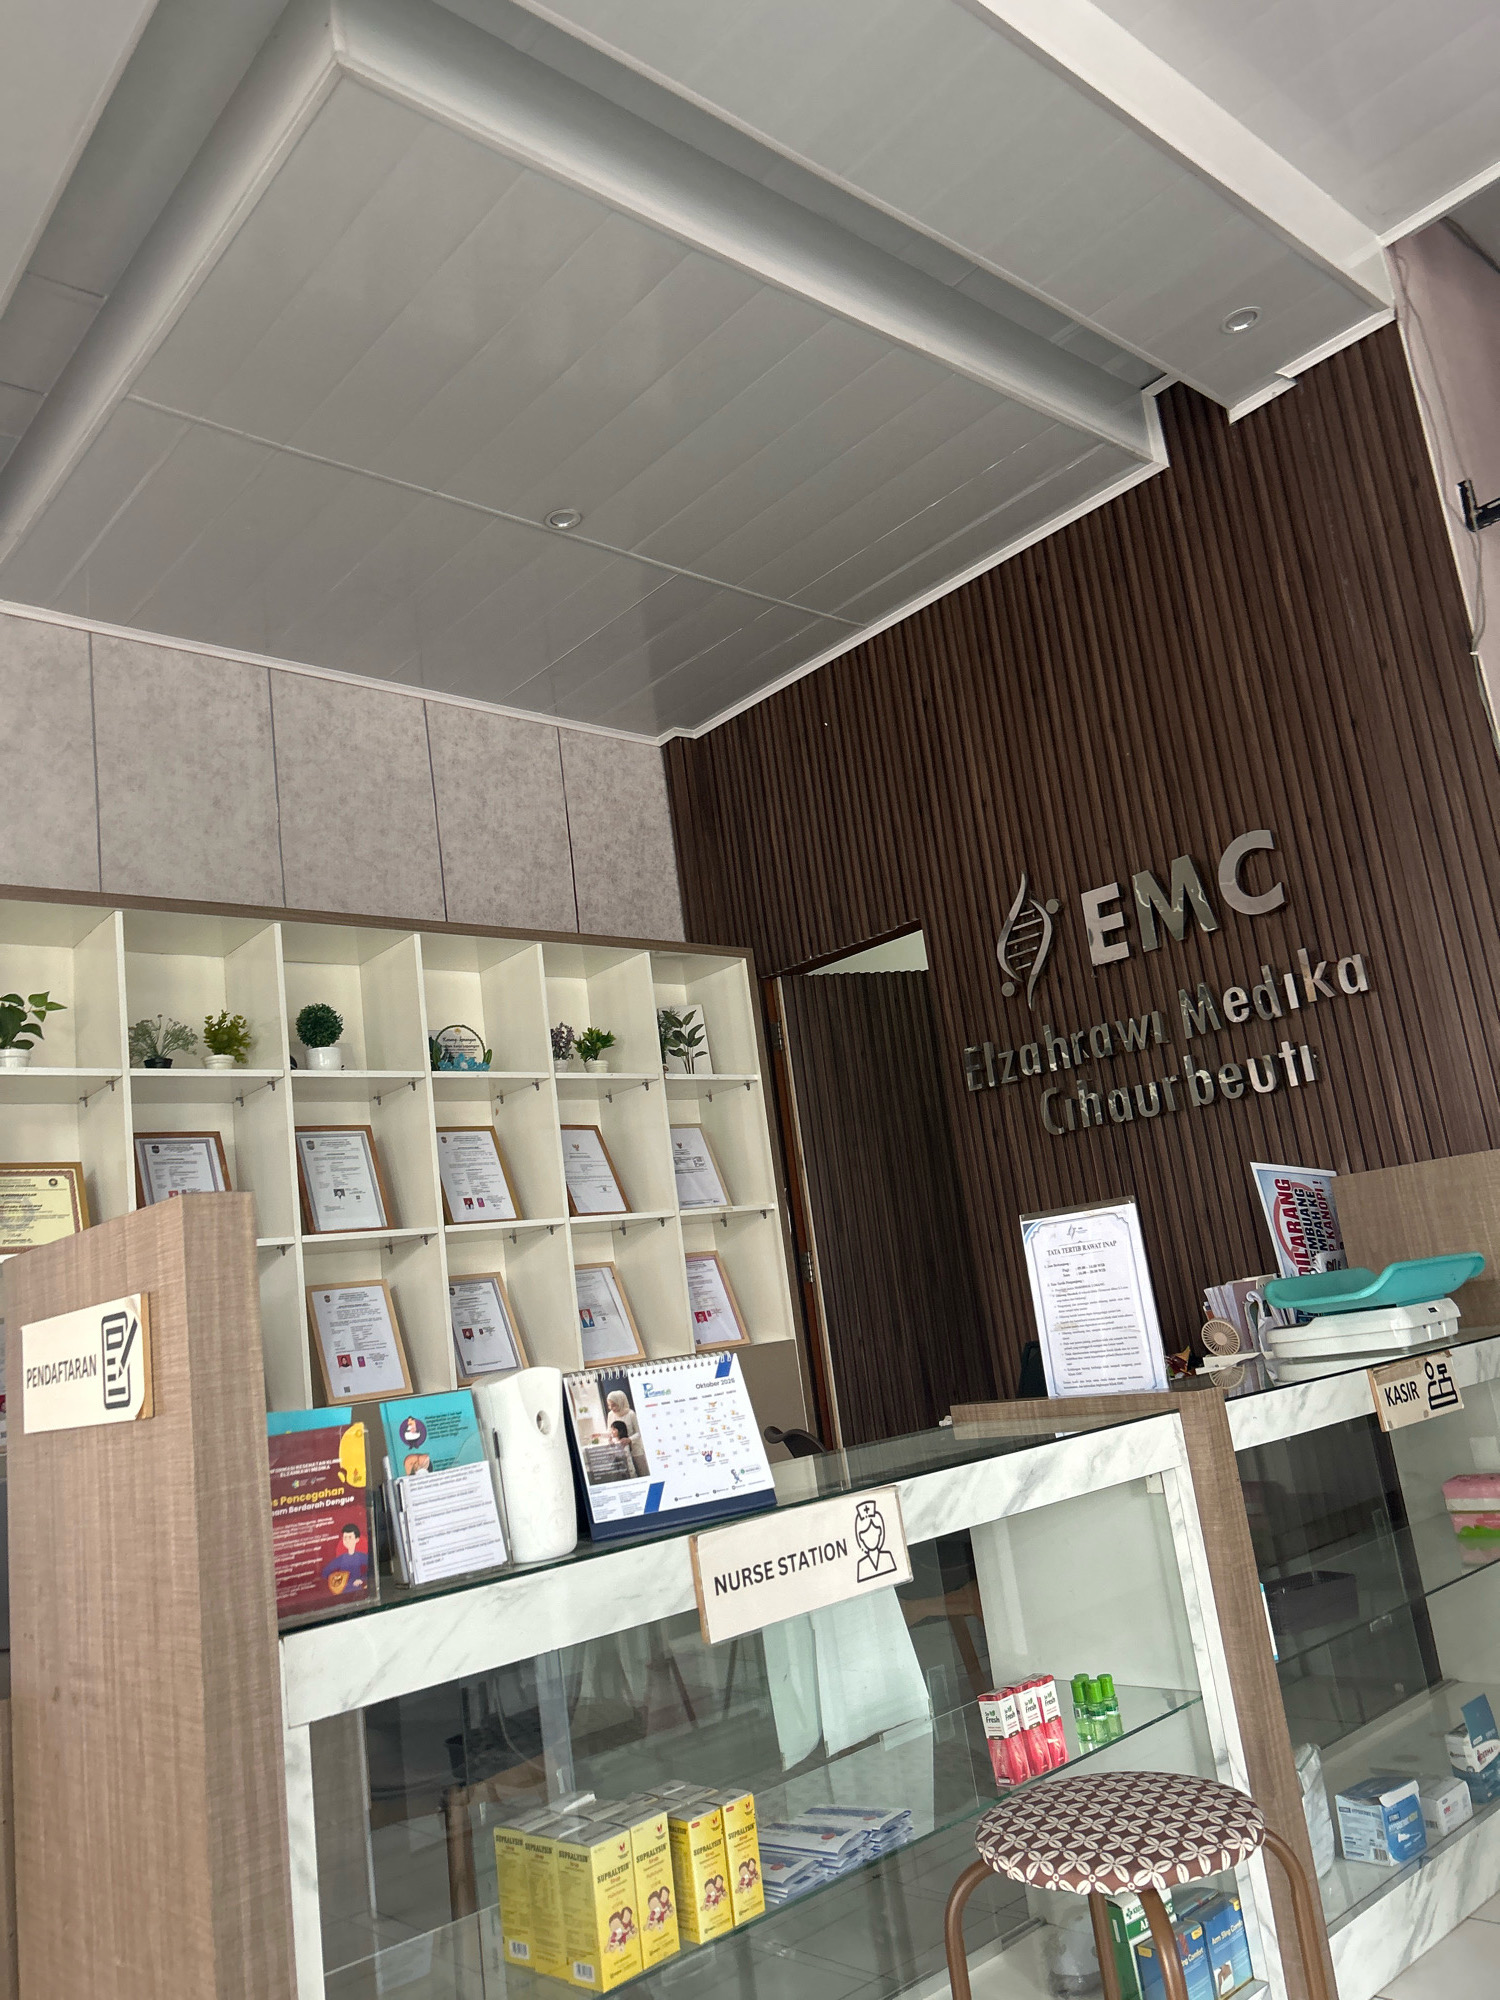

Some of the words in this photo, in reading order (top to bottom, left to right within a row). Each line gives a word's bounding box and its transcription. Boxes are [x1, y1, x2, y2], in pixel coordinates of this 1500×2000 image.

[1081, 829, 1286, 966] EMC
[964, 1010, 1170, 1092] Elzahrawi
[1178, 947, 1370, 1039] Medika
[1305, 1190, 1318, 1208] KE
[1314, 1188, 1334, 1240] KANOPI
[1274, 1178, 1312, 1277] DILARANG
[1294, 1188, 1318, 1261] EMBUANG
[1061, 1245, 1082, 1254] TERTIB
[1082, 1242, 1102, 1251] RAWAT
[1102, 1240, 1117, 1248] INAP
[26, 1353, 97, 1390] PENDAFTARAN
[695, 1381, 720, 1389] Oktober
[1384, 1380, 1420, 1407] KASIR
[280, 1487, 344, 1505] Pencegahan
[288, 1501, 324, 1514] Berdarah
[325, 1495, 355, 1507] Dengue
[714, 1560, 775, 1596] NURSE
[777, 1538, 848, 1576] STATION
[496, 1834, 523, 1846] SUPRALYSIN
[727, 1822, 755, 1840] SUPRALYSIN
[525, 1843, 553, 1854] SUPRALYSIN
[636, 1842, 667, 1863] SUPRALYSIN
[693, 1838, 723, 1856] SUPRALYSIN
[558, 1850, 588, 1863] SUPRALYSIN
[597, 1861, 630, 1884] SUPRALYSIN
[1211, 1934, 1222, 1945] Arm
[1188, 1946, 1204, 1962] Comfort
